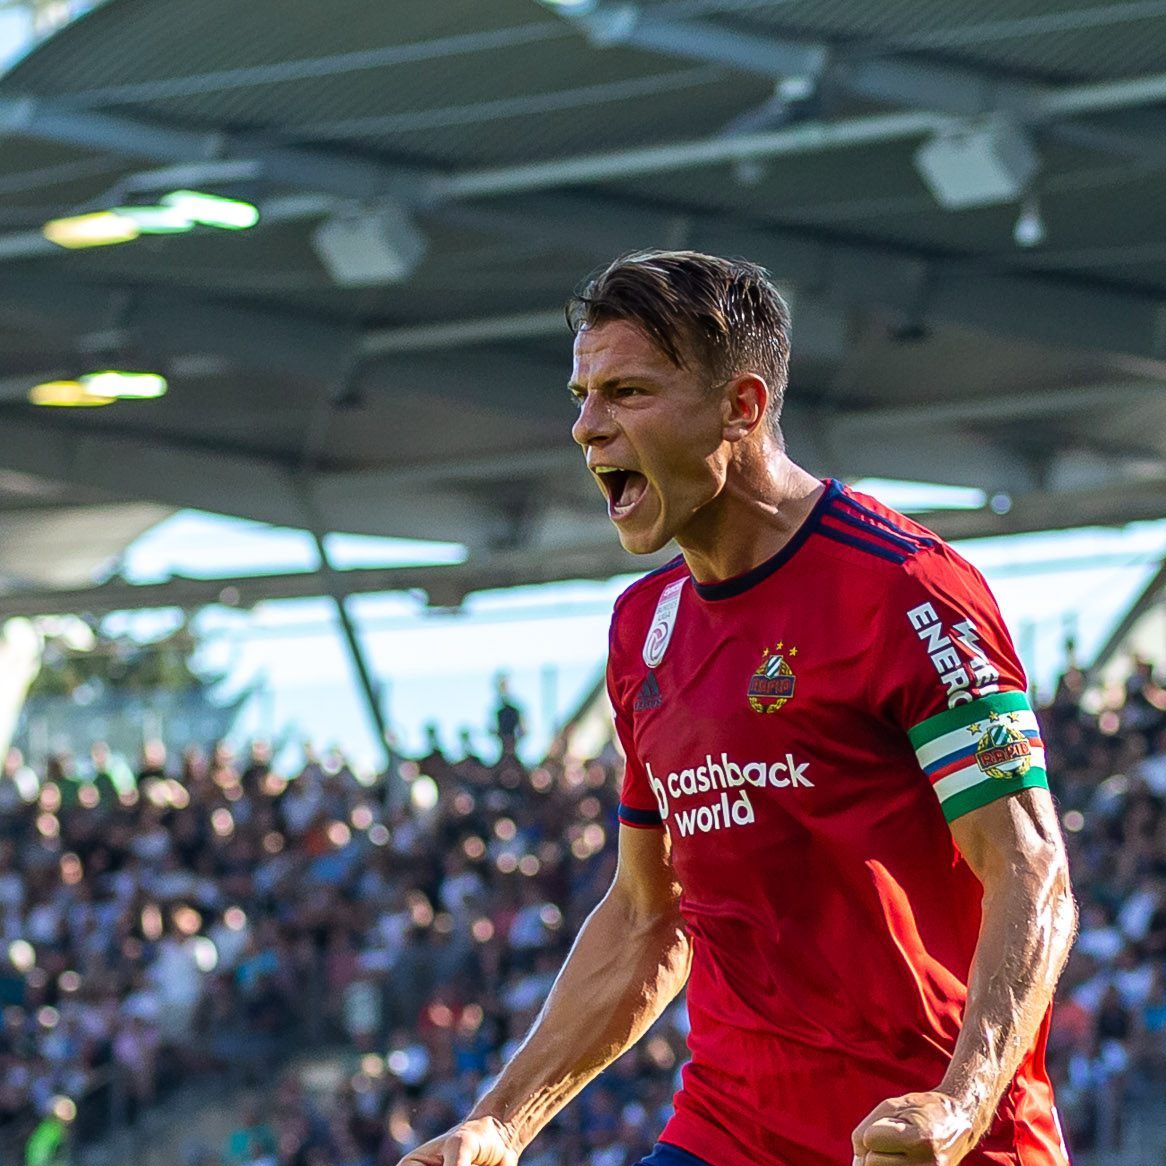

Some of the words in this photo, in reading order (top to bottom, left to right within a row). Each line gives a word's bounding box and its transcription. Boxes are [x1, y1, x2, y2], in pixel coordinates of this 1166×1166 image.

[667, 752, 815, 799] cashback
[980, 742, 1031, 767] RAPID
[674, 789, 755, 838] world
